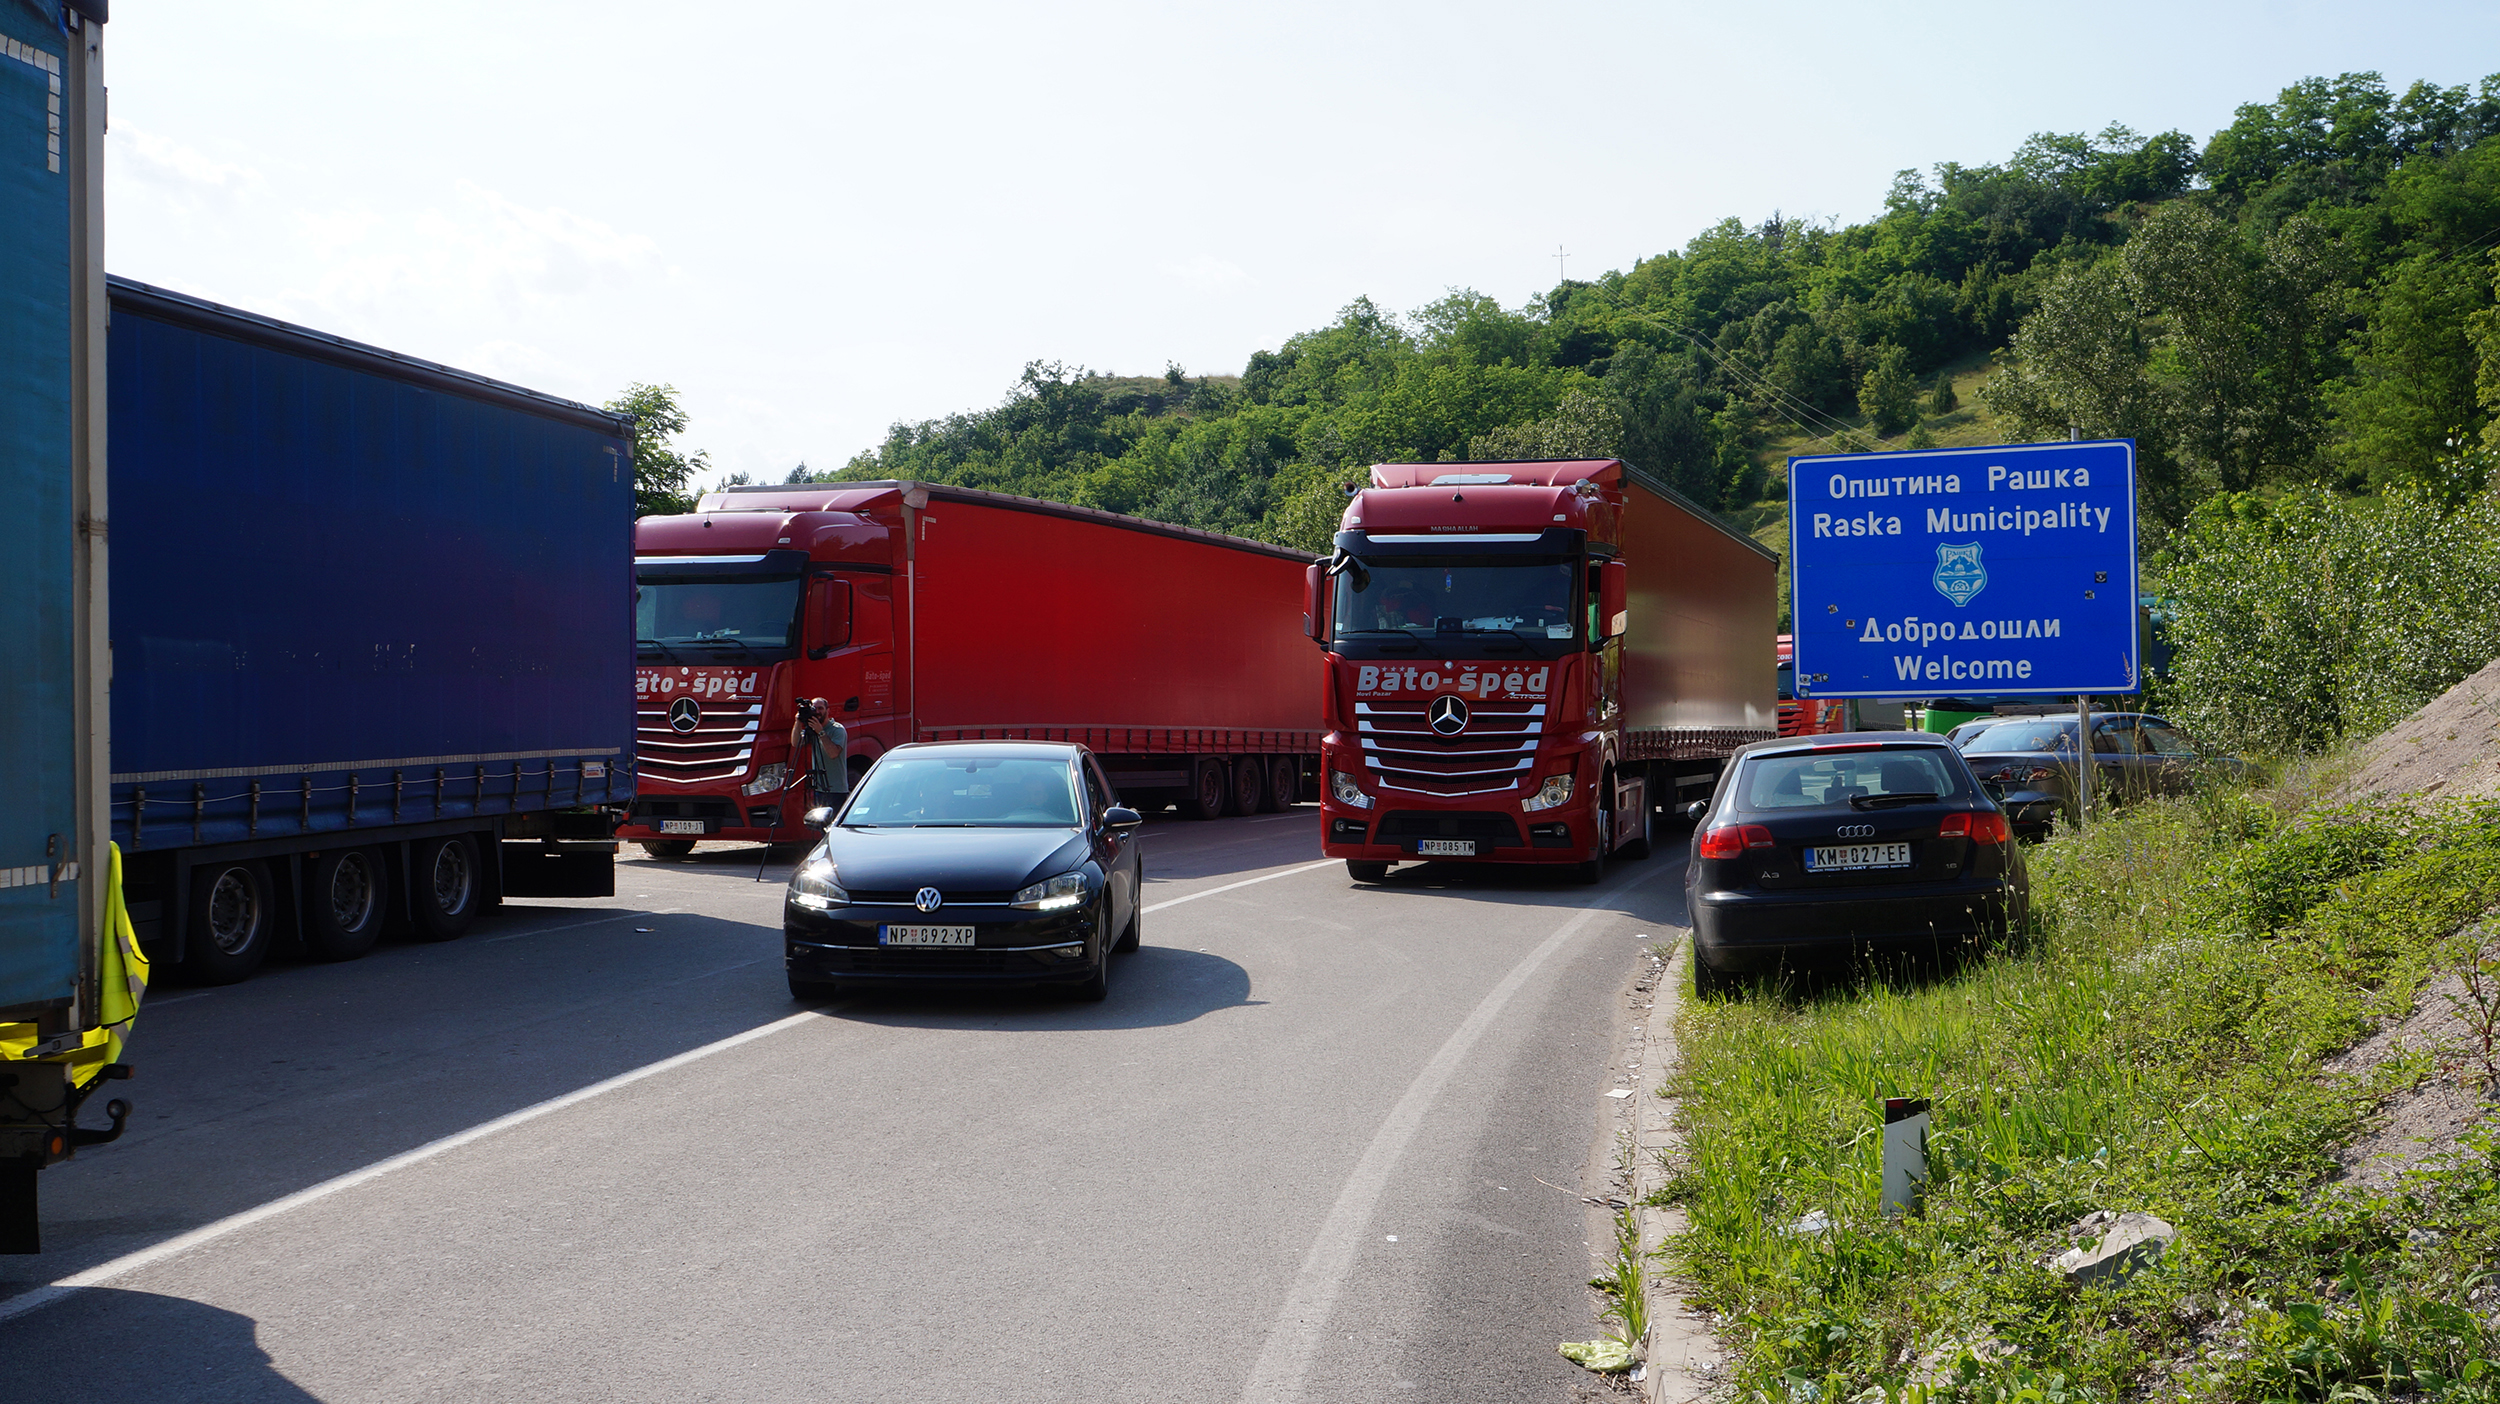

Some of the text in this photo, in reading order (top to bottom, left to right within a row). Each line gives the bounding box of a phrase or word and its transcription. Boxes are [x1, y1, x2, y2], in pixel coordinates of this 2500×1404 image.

[1829, 466, 2090, 499] Општина Рашка
[1814, 502, 2111, 538] Raska Municipality
[1859, 617, 2061, 647] Добродошли
[1894, 655, 2032, 681] Welcome
[635, 671, 757, 698] ato-šped
[1816, 848, 1837, 866] KM
[890, 927, 908, 943] NP
